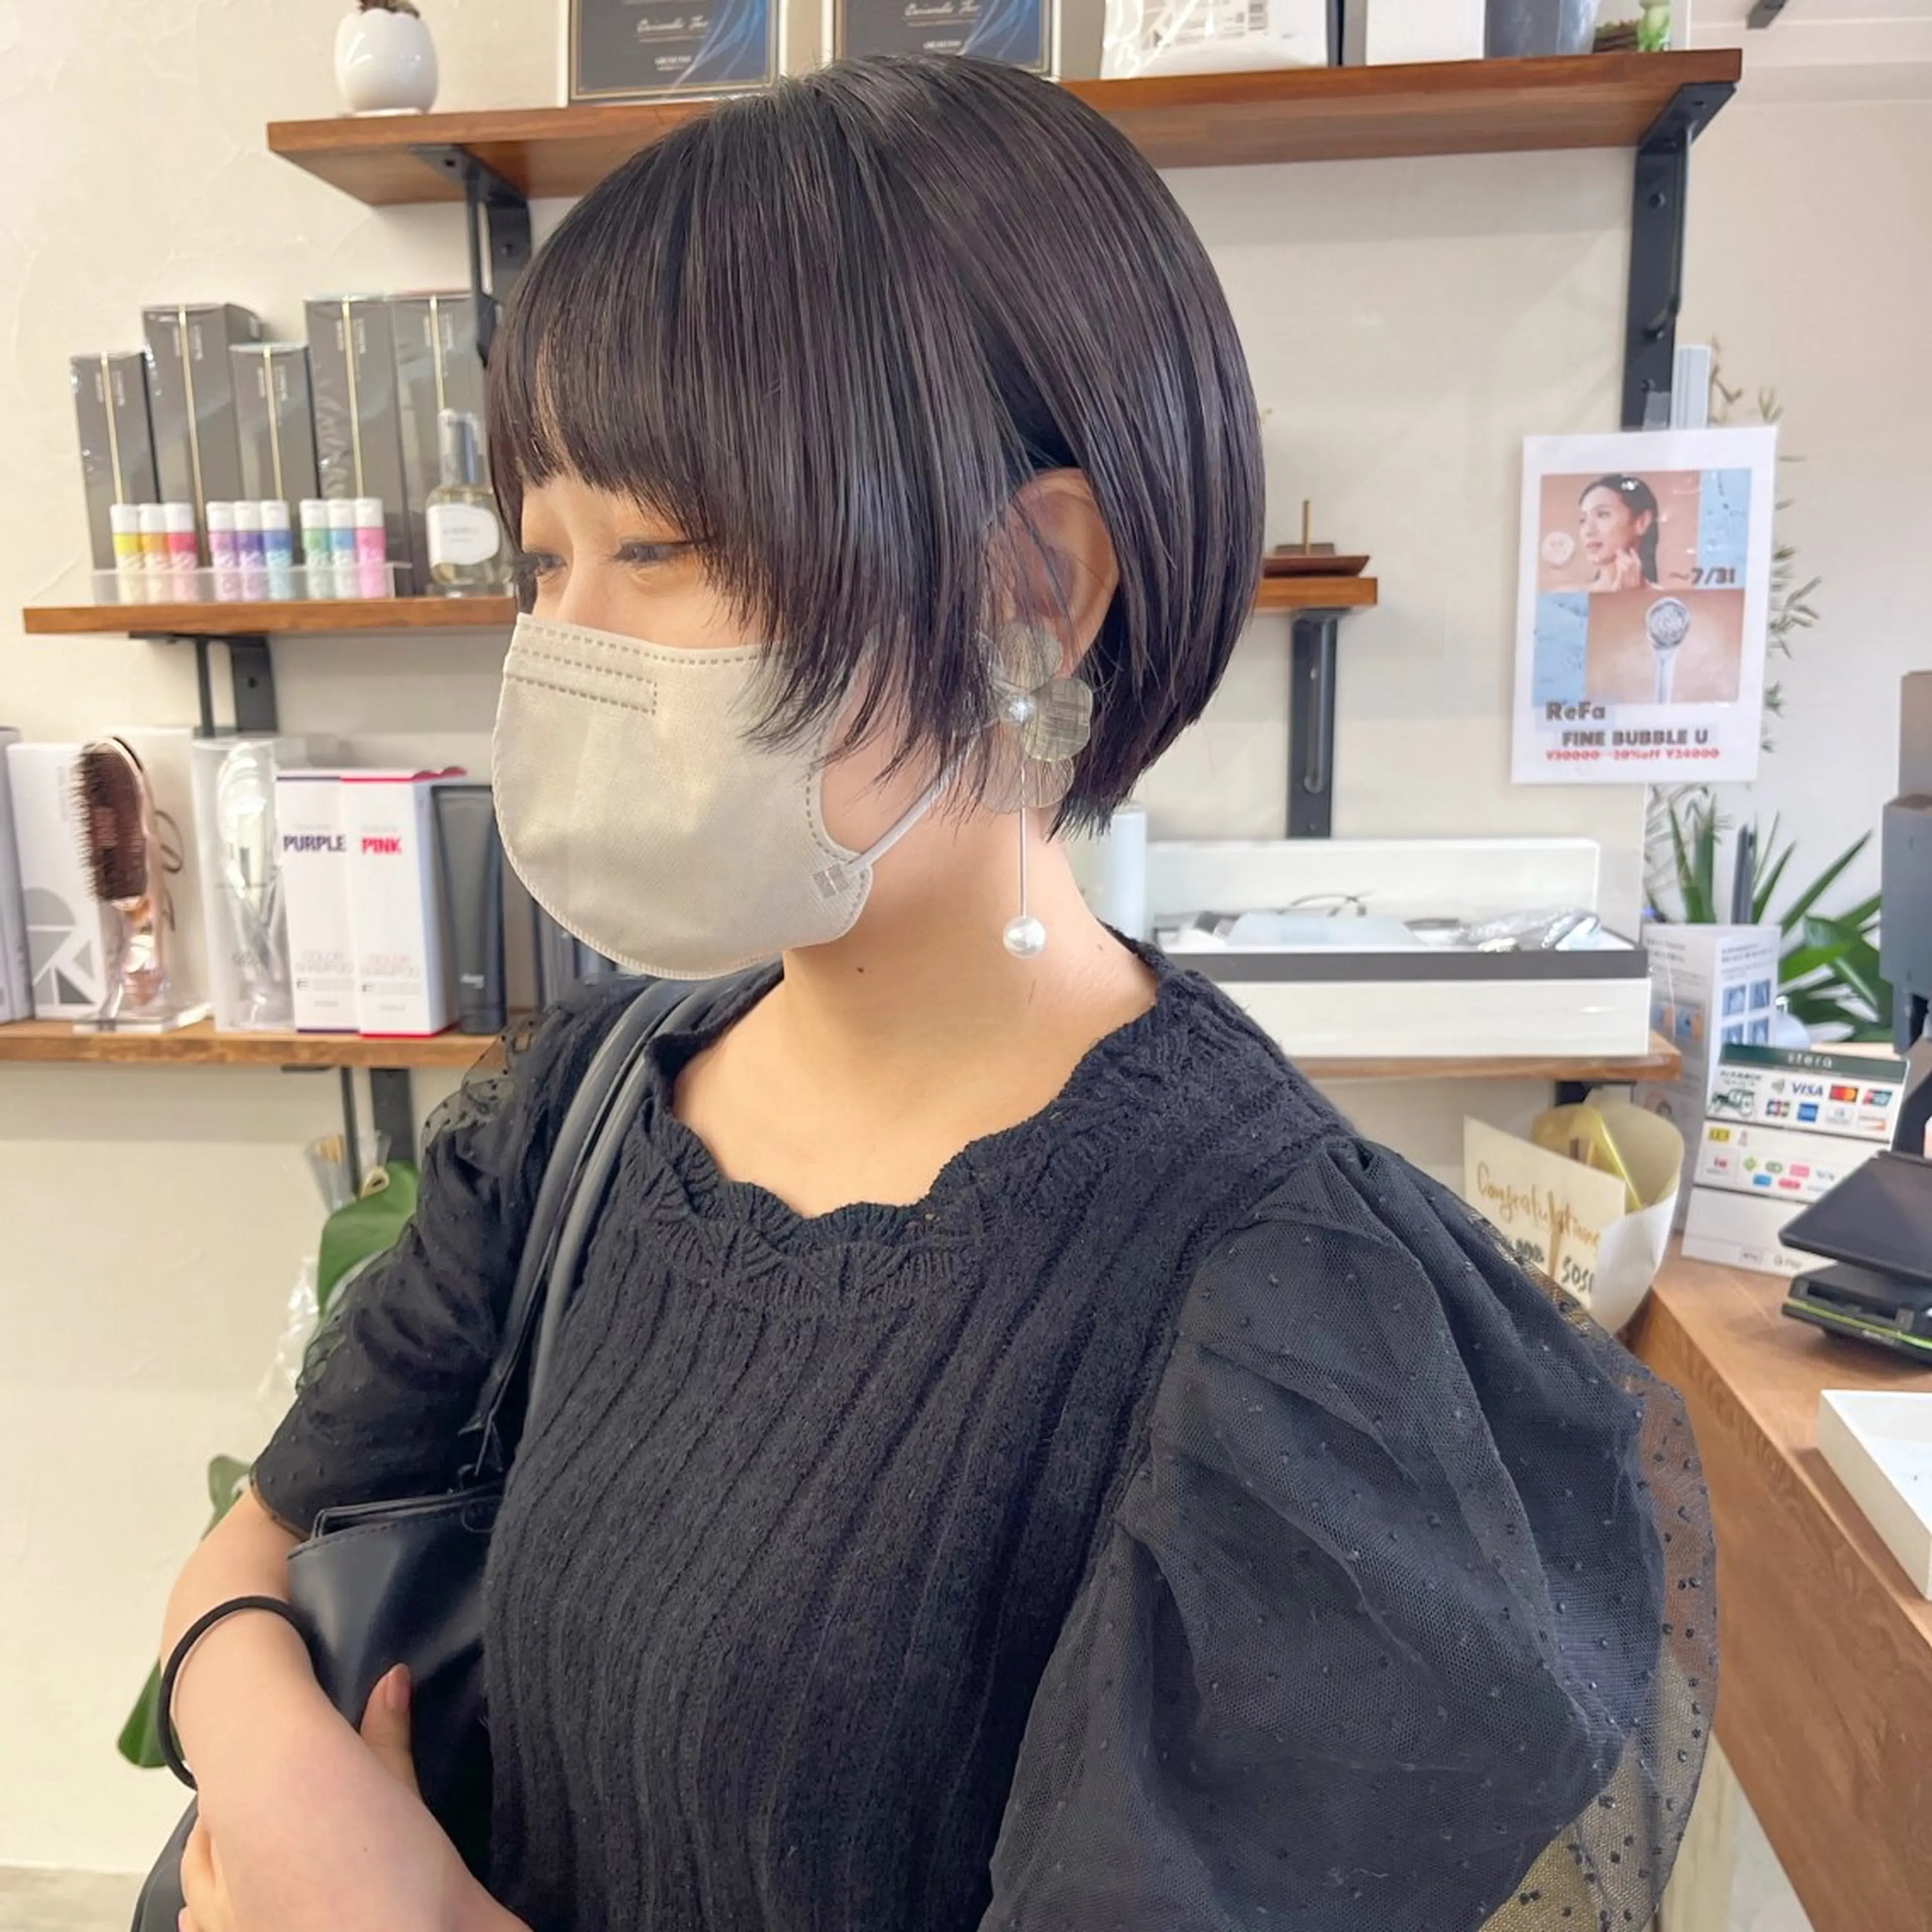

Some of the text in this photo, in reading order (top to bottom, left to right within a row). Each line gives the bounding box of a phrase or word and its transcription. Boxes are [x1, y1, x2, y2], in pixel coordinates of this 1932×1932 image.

[1546, 702, 1606, 720] ReFa
[1562, 730, 1709, 747] FINE BUBBLE U
[283, 835, 347, 852] PURPLE
[361, 837, 402, 854] PINK
[1792, 1082, 1823, 1096] VISA
